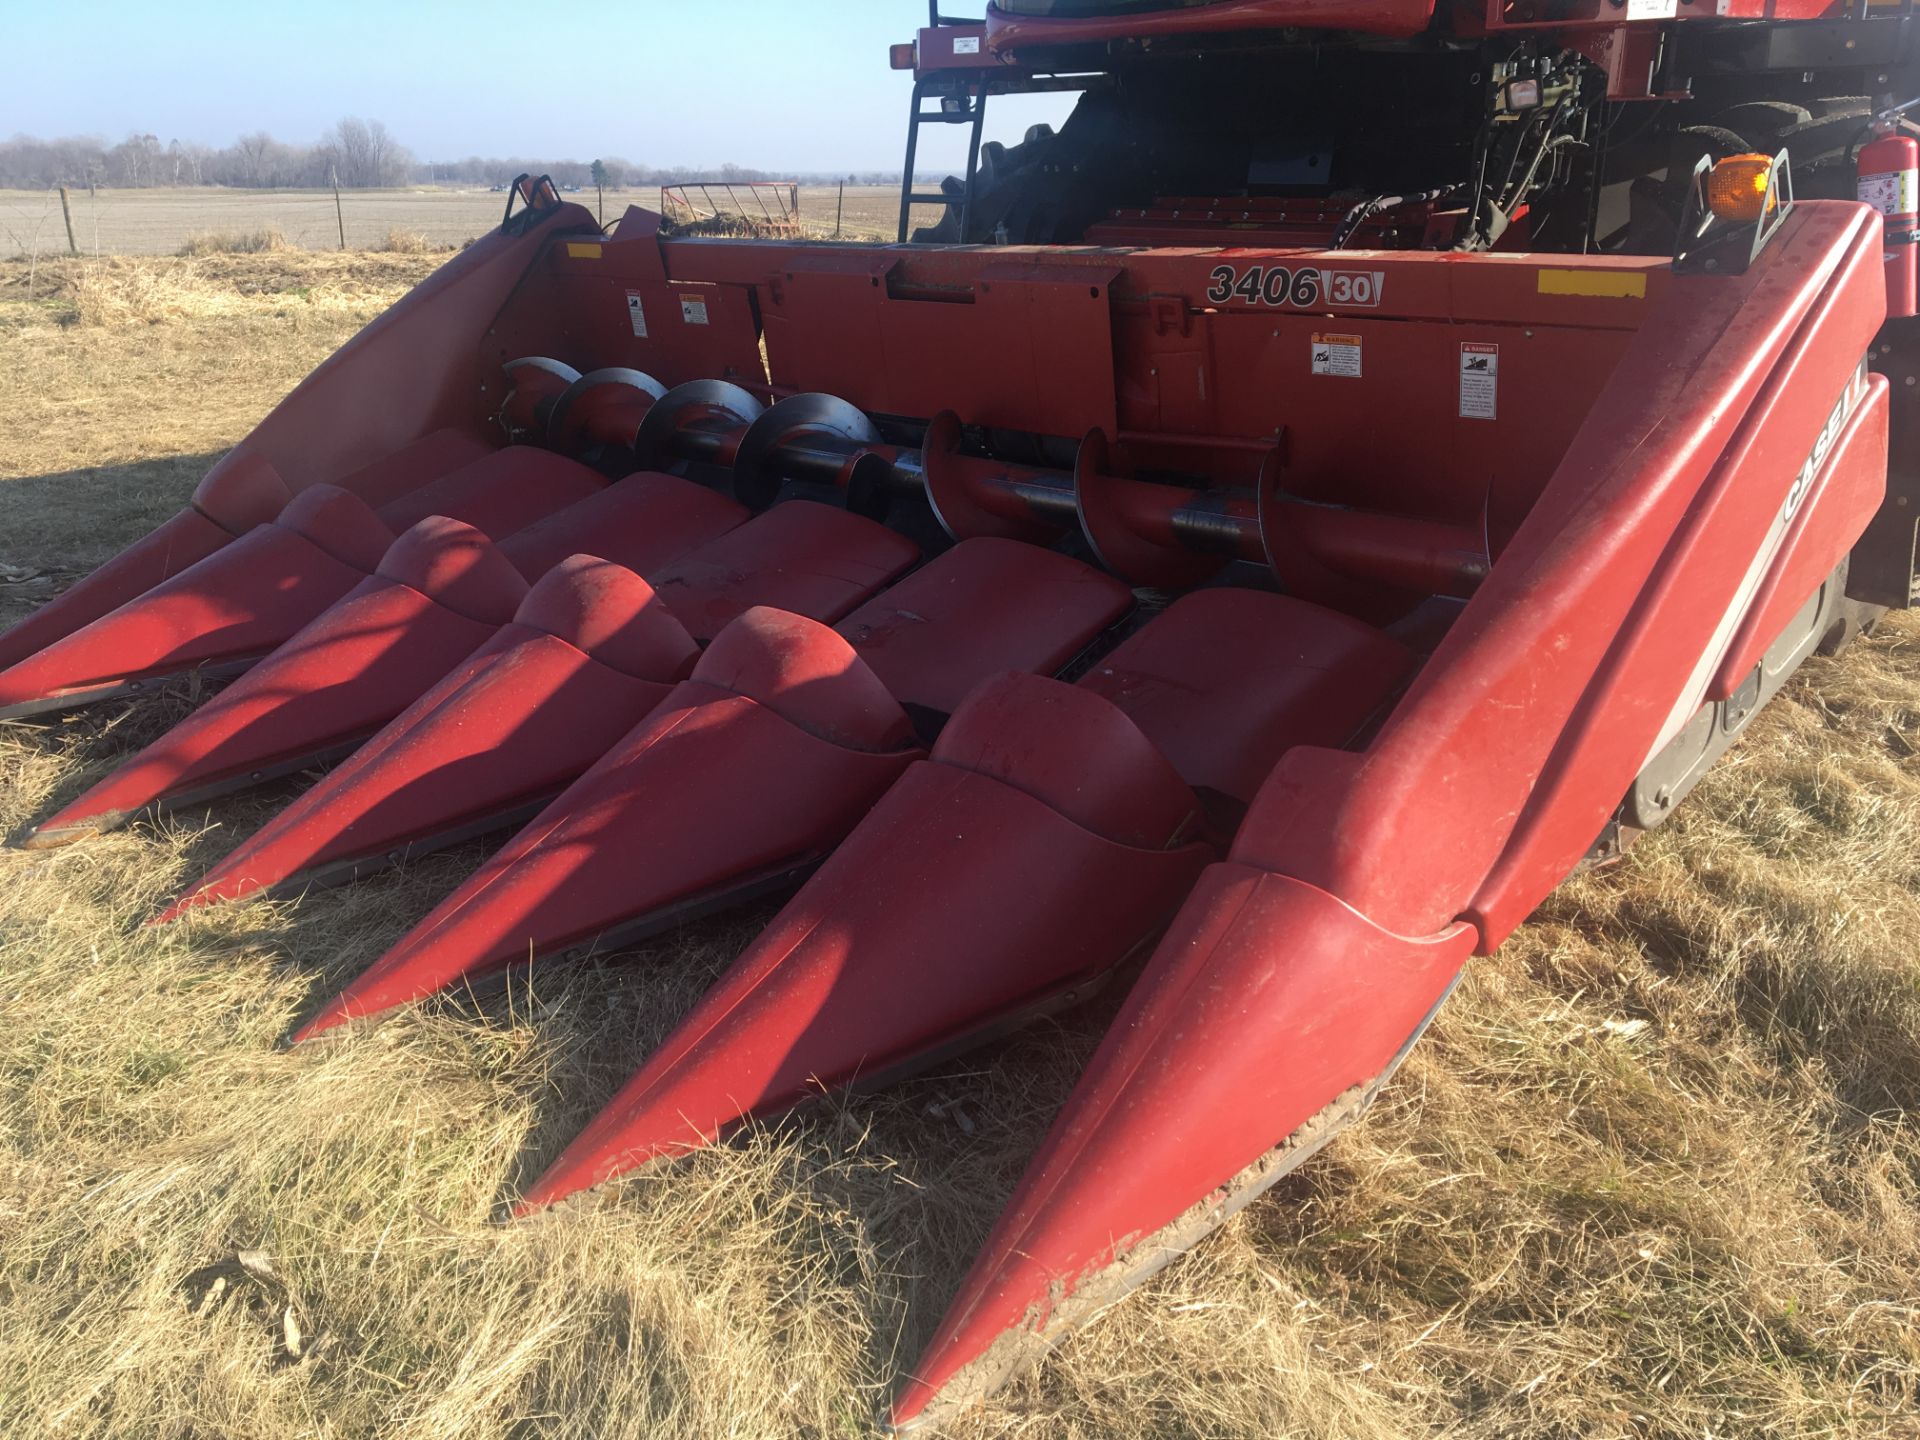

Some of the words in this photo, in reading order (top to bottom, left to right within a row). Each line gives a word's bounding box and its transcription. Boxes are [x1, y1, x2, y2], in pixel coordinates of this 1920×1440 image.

[1207, 265, 1321, 308] 3406
[1334, 275, 1370, 303] 30
[1326, 335, 1356, 344] WARNING
[1784, 399, 1842, 523] CASE
